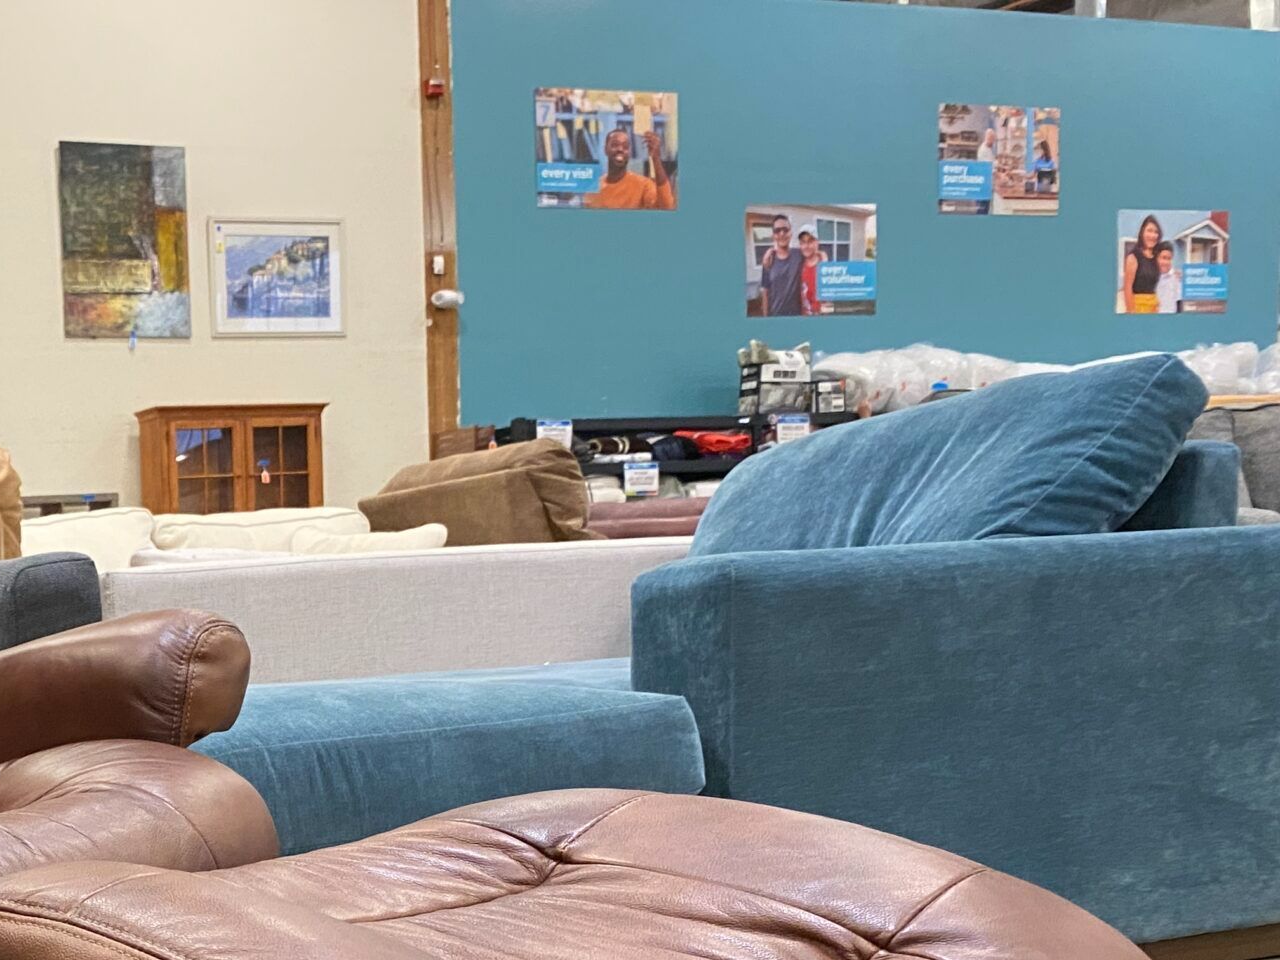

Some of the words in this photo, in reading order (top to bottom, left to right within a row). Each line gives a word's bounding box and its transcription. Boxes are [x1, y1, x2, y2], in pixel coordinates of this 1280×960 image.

[541, 168, 571, 180] every
[573, 168, 593, 179] visit
[943, 166, 968, 176] every
[821, 266, 848, 276] every
